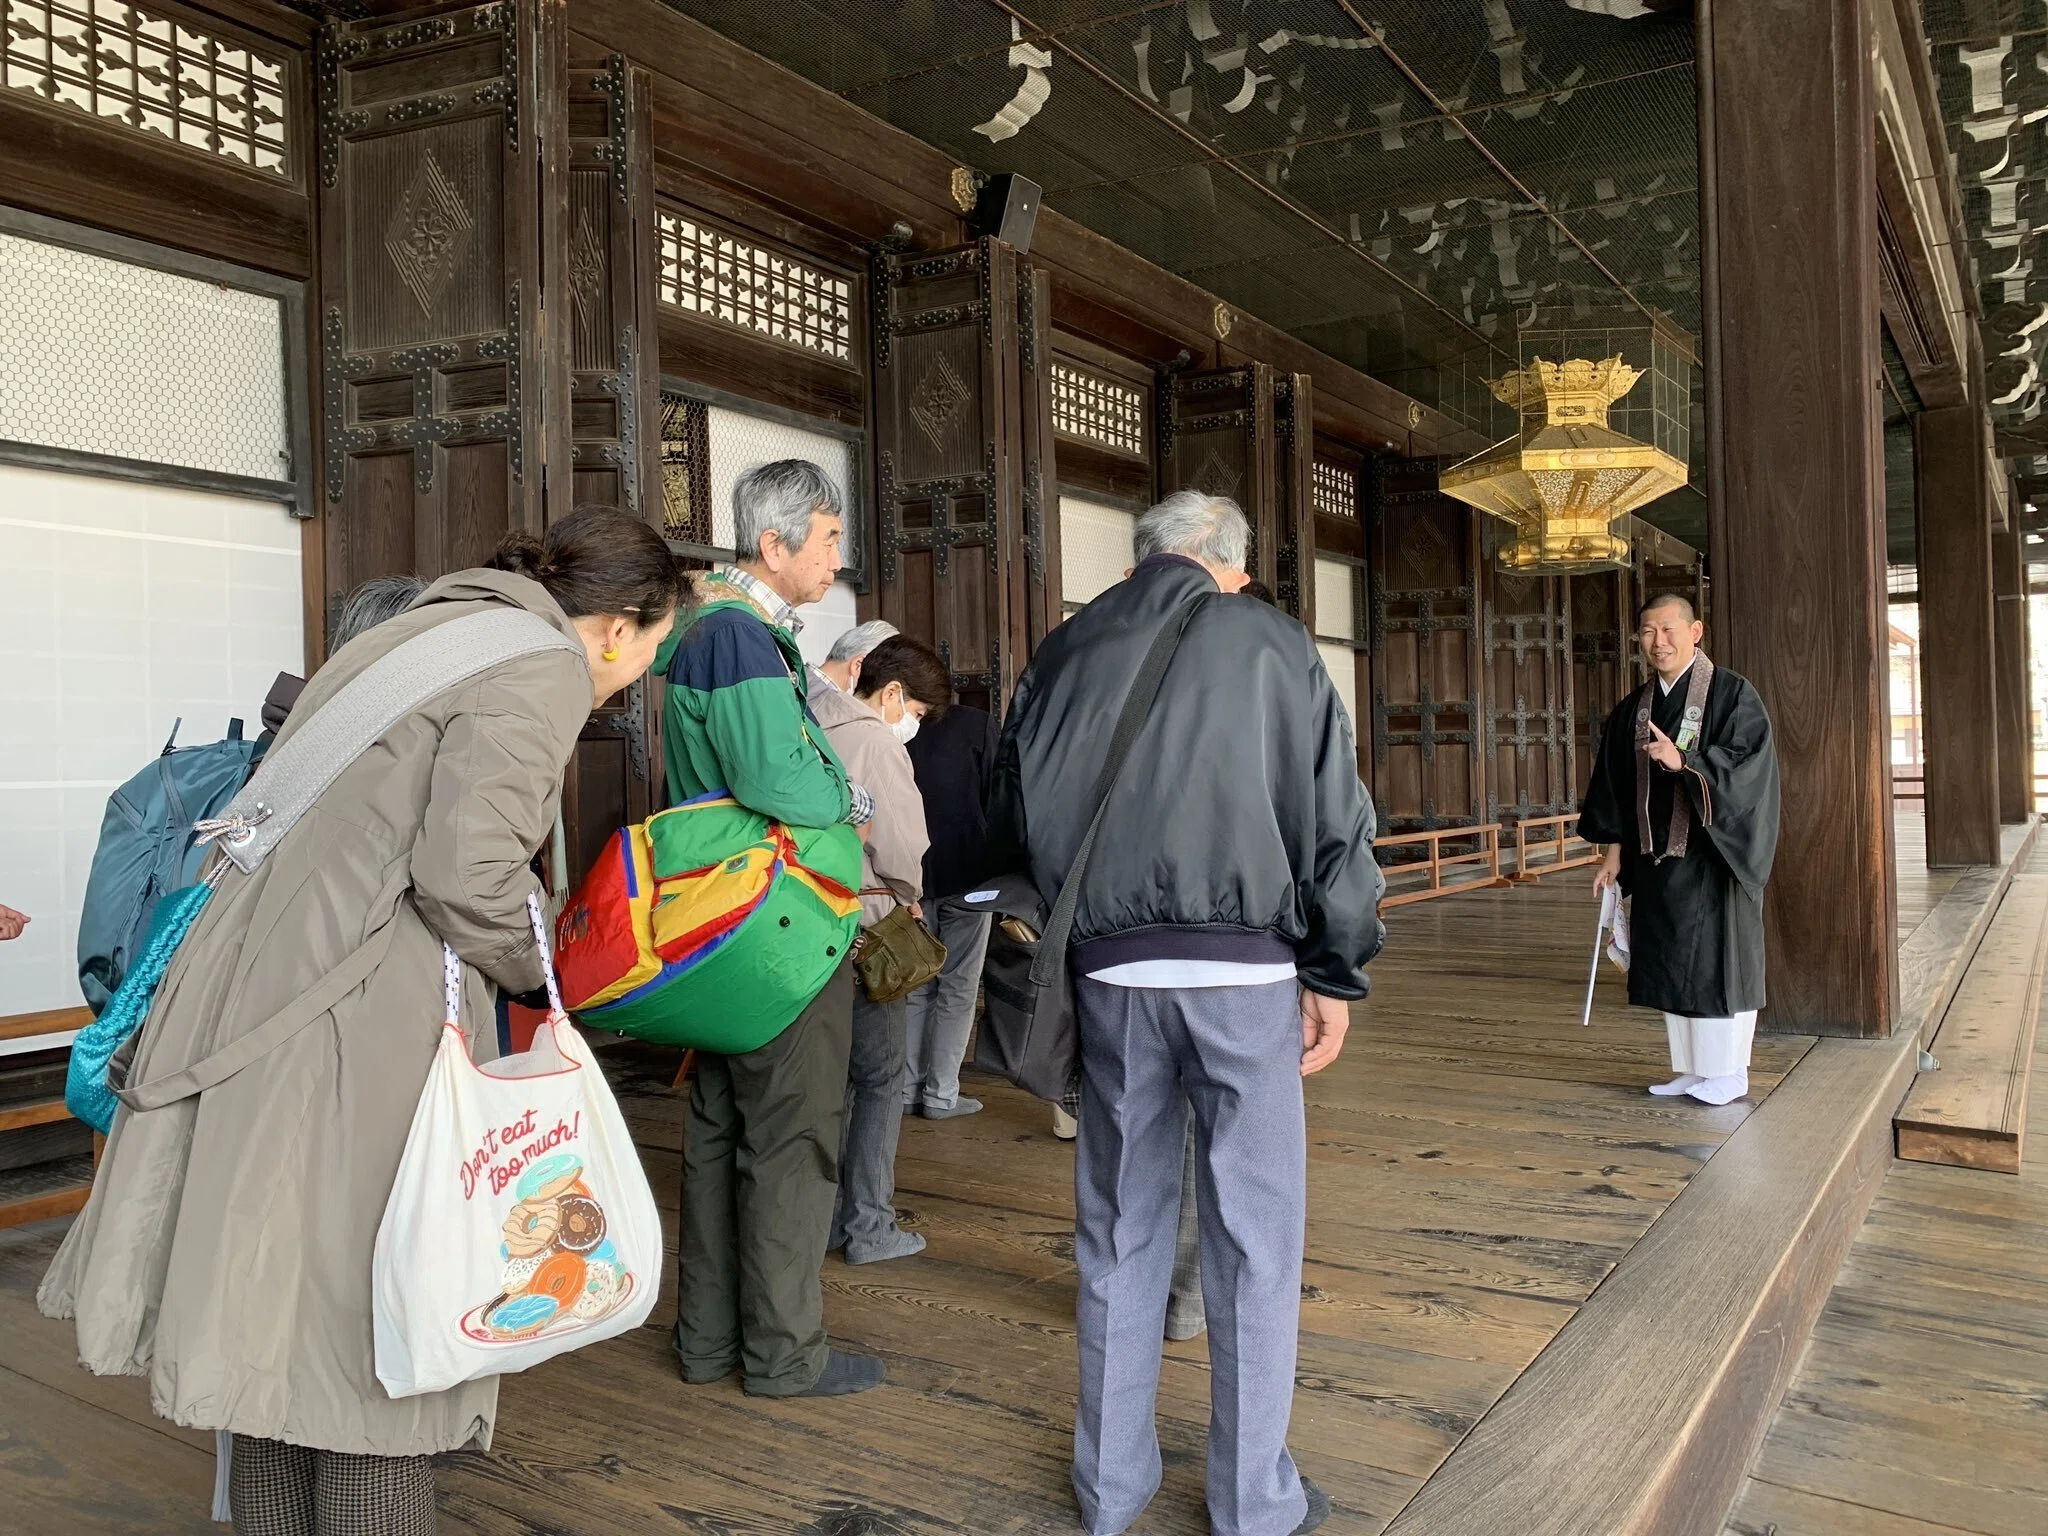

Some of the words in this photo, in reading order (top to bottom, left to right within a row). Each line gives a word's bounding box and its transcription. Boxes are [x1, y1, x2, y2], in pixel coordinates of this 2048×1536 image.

[459, 1128, 499, 1201] Don't
[501, 1109, 538, 1146] eat
[487, 1156, 524, 1196] too
[521, 1110, 580, 1166] much!
